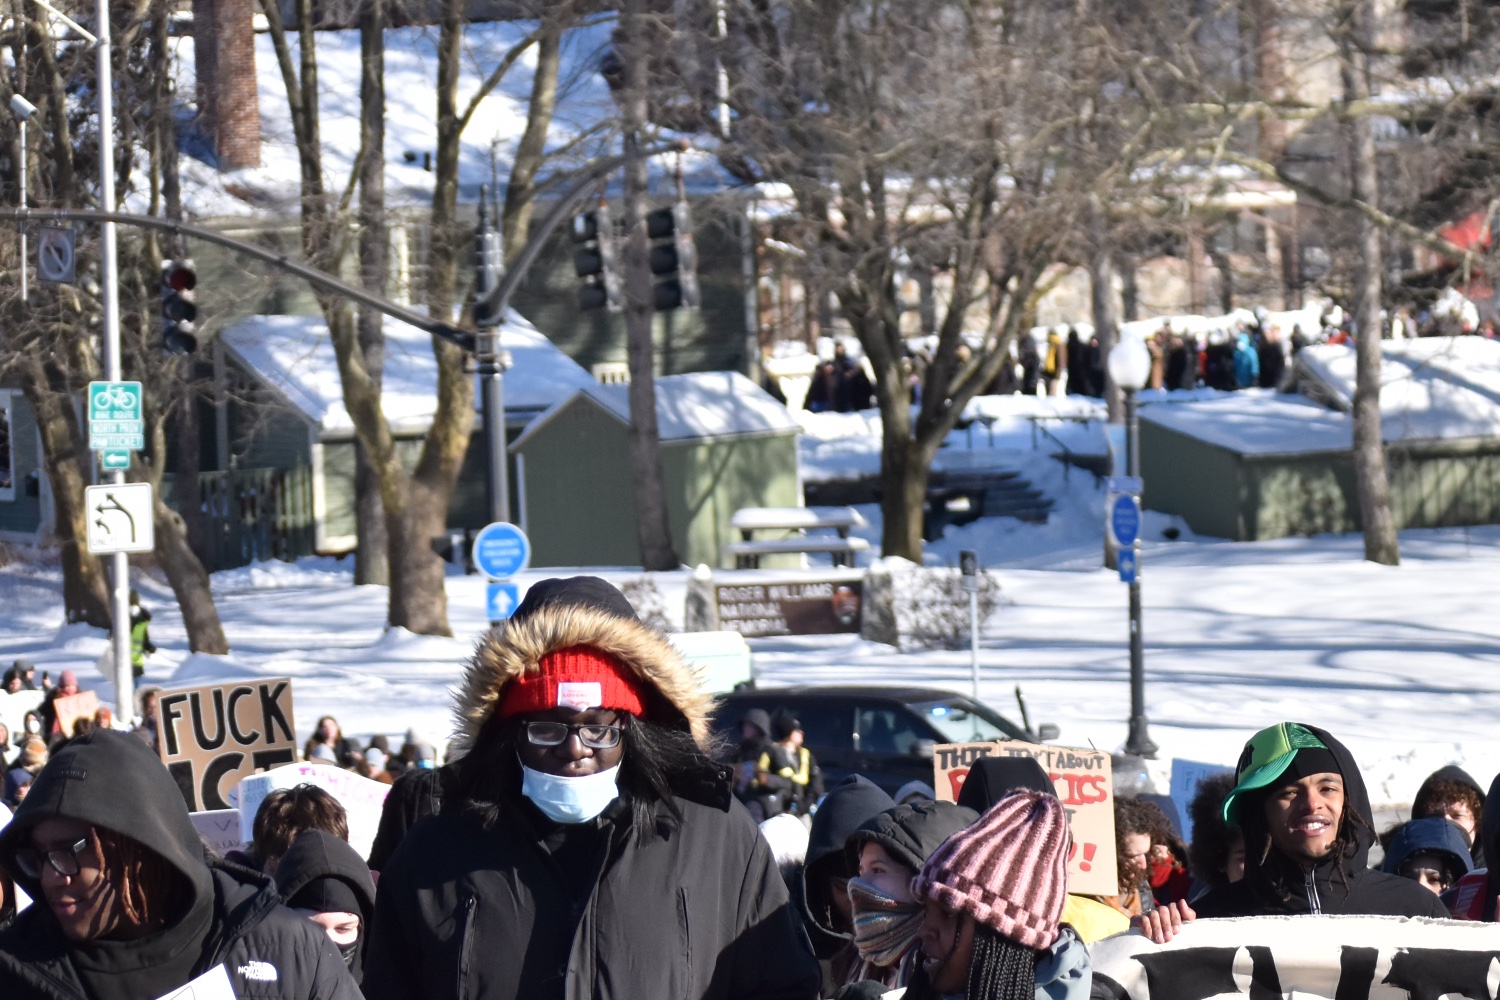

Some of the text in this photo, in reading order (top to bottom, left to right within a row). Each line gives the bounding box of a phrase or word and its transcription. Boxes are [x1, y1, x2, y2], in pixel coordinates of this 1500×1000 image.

[113, 411, 135, 419] ROUTE
[92, 436, 142, 447] PAWTUCKET
[719, 583, 834, 602] ROGER WILLIAMS
[720, 602, 783, 618] NATIONAL
[721, 618, 791, 635] MEMORIAL
[160, 681, 294, 755] FUCK
[1056, 751, 1104, 770] ABOUT
[166, 747, 294, 811] IC
